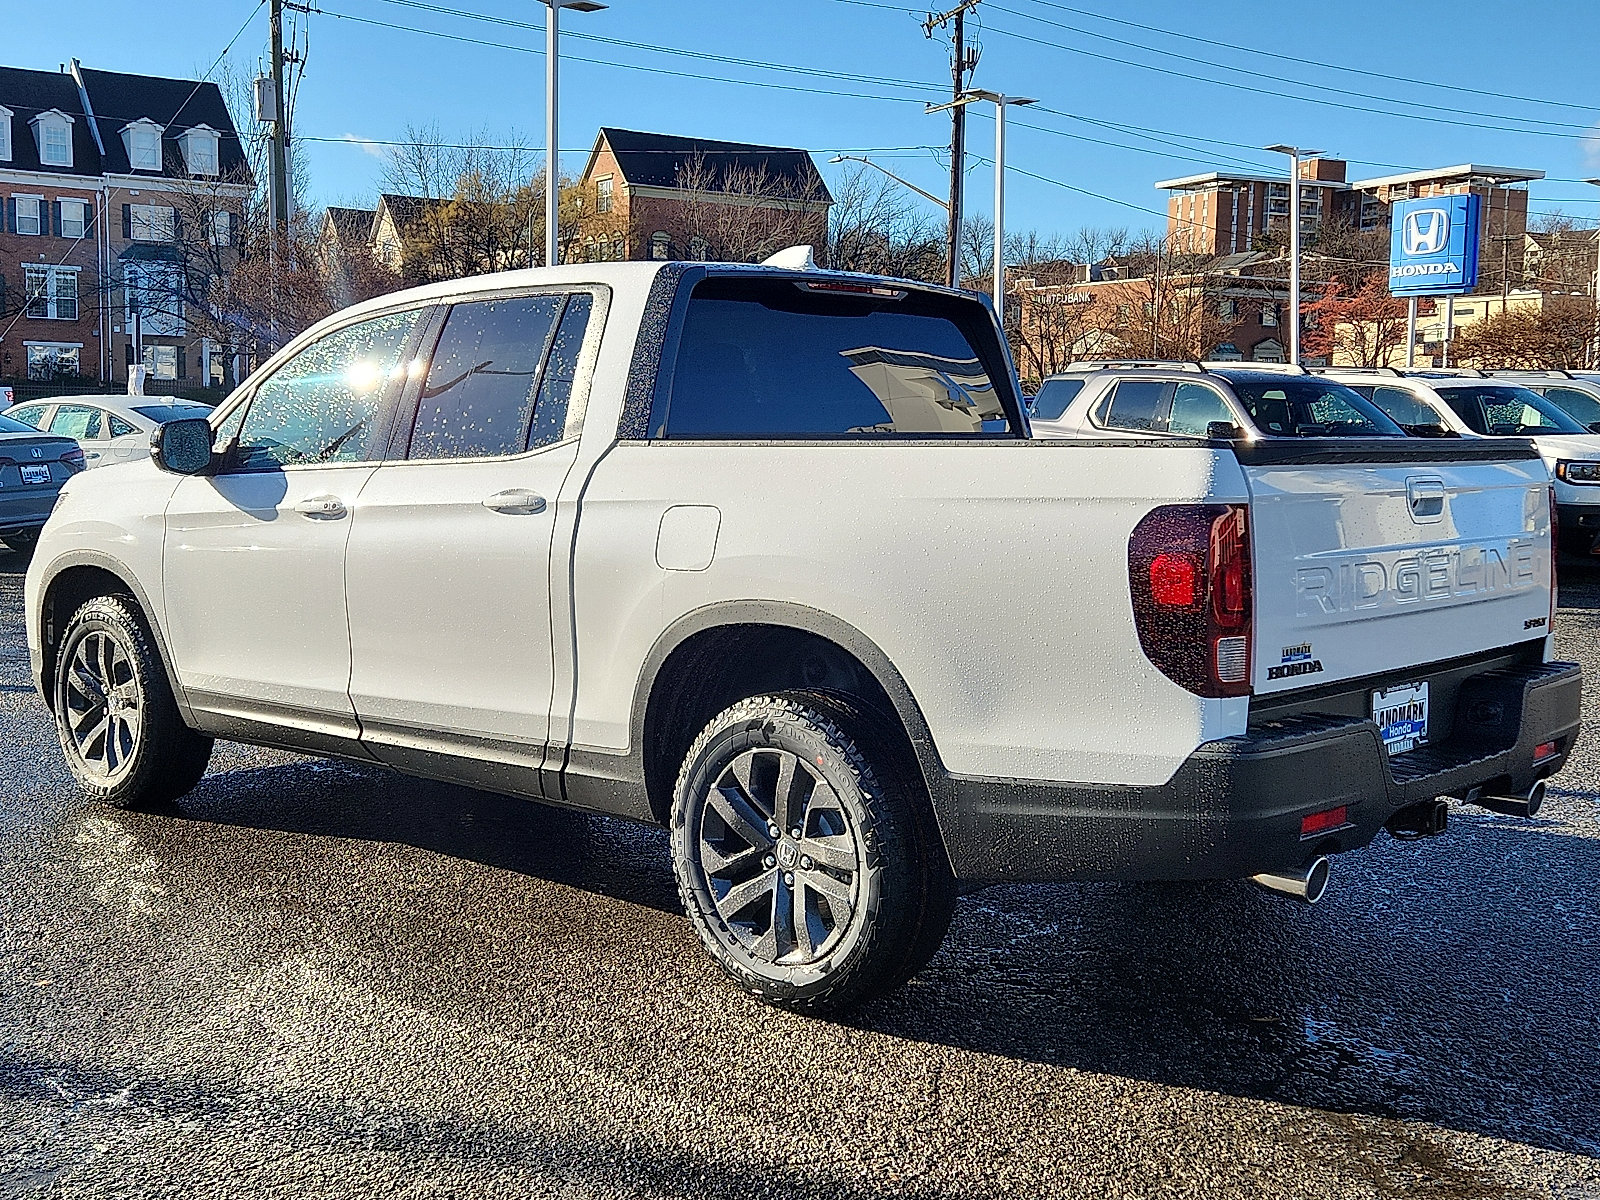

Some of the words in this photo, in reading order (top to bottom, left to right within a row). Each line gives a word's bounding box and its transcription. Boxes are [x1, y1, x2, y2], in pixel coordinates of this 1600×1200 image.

[1391, 262, 1461, 278] HONDA
[1296, 544, 1534, 616] RIDGELINE
[1267, 660, 1324, 680] HONDA
[1374, 702, 1424, 728] LANDMARK
[1389, 722, 1412, 738] Honda
